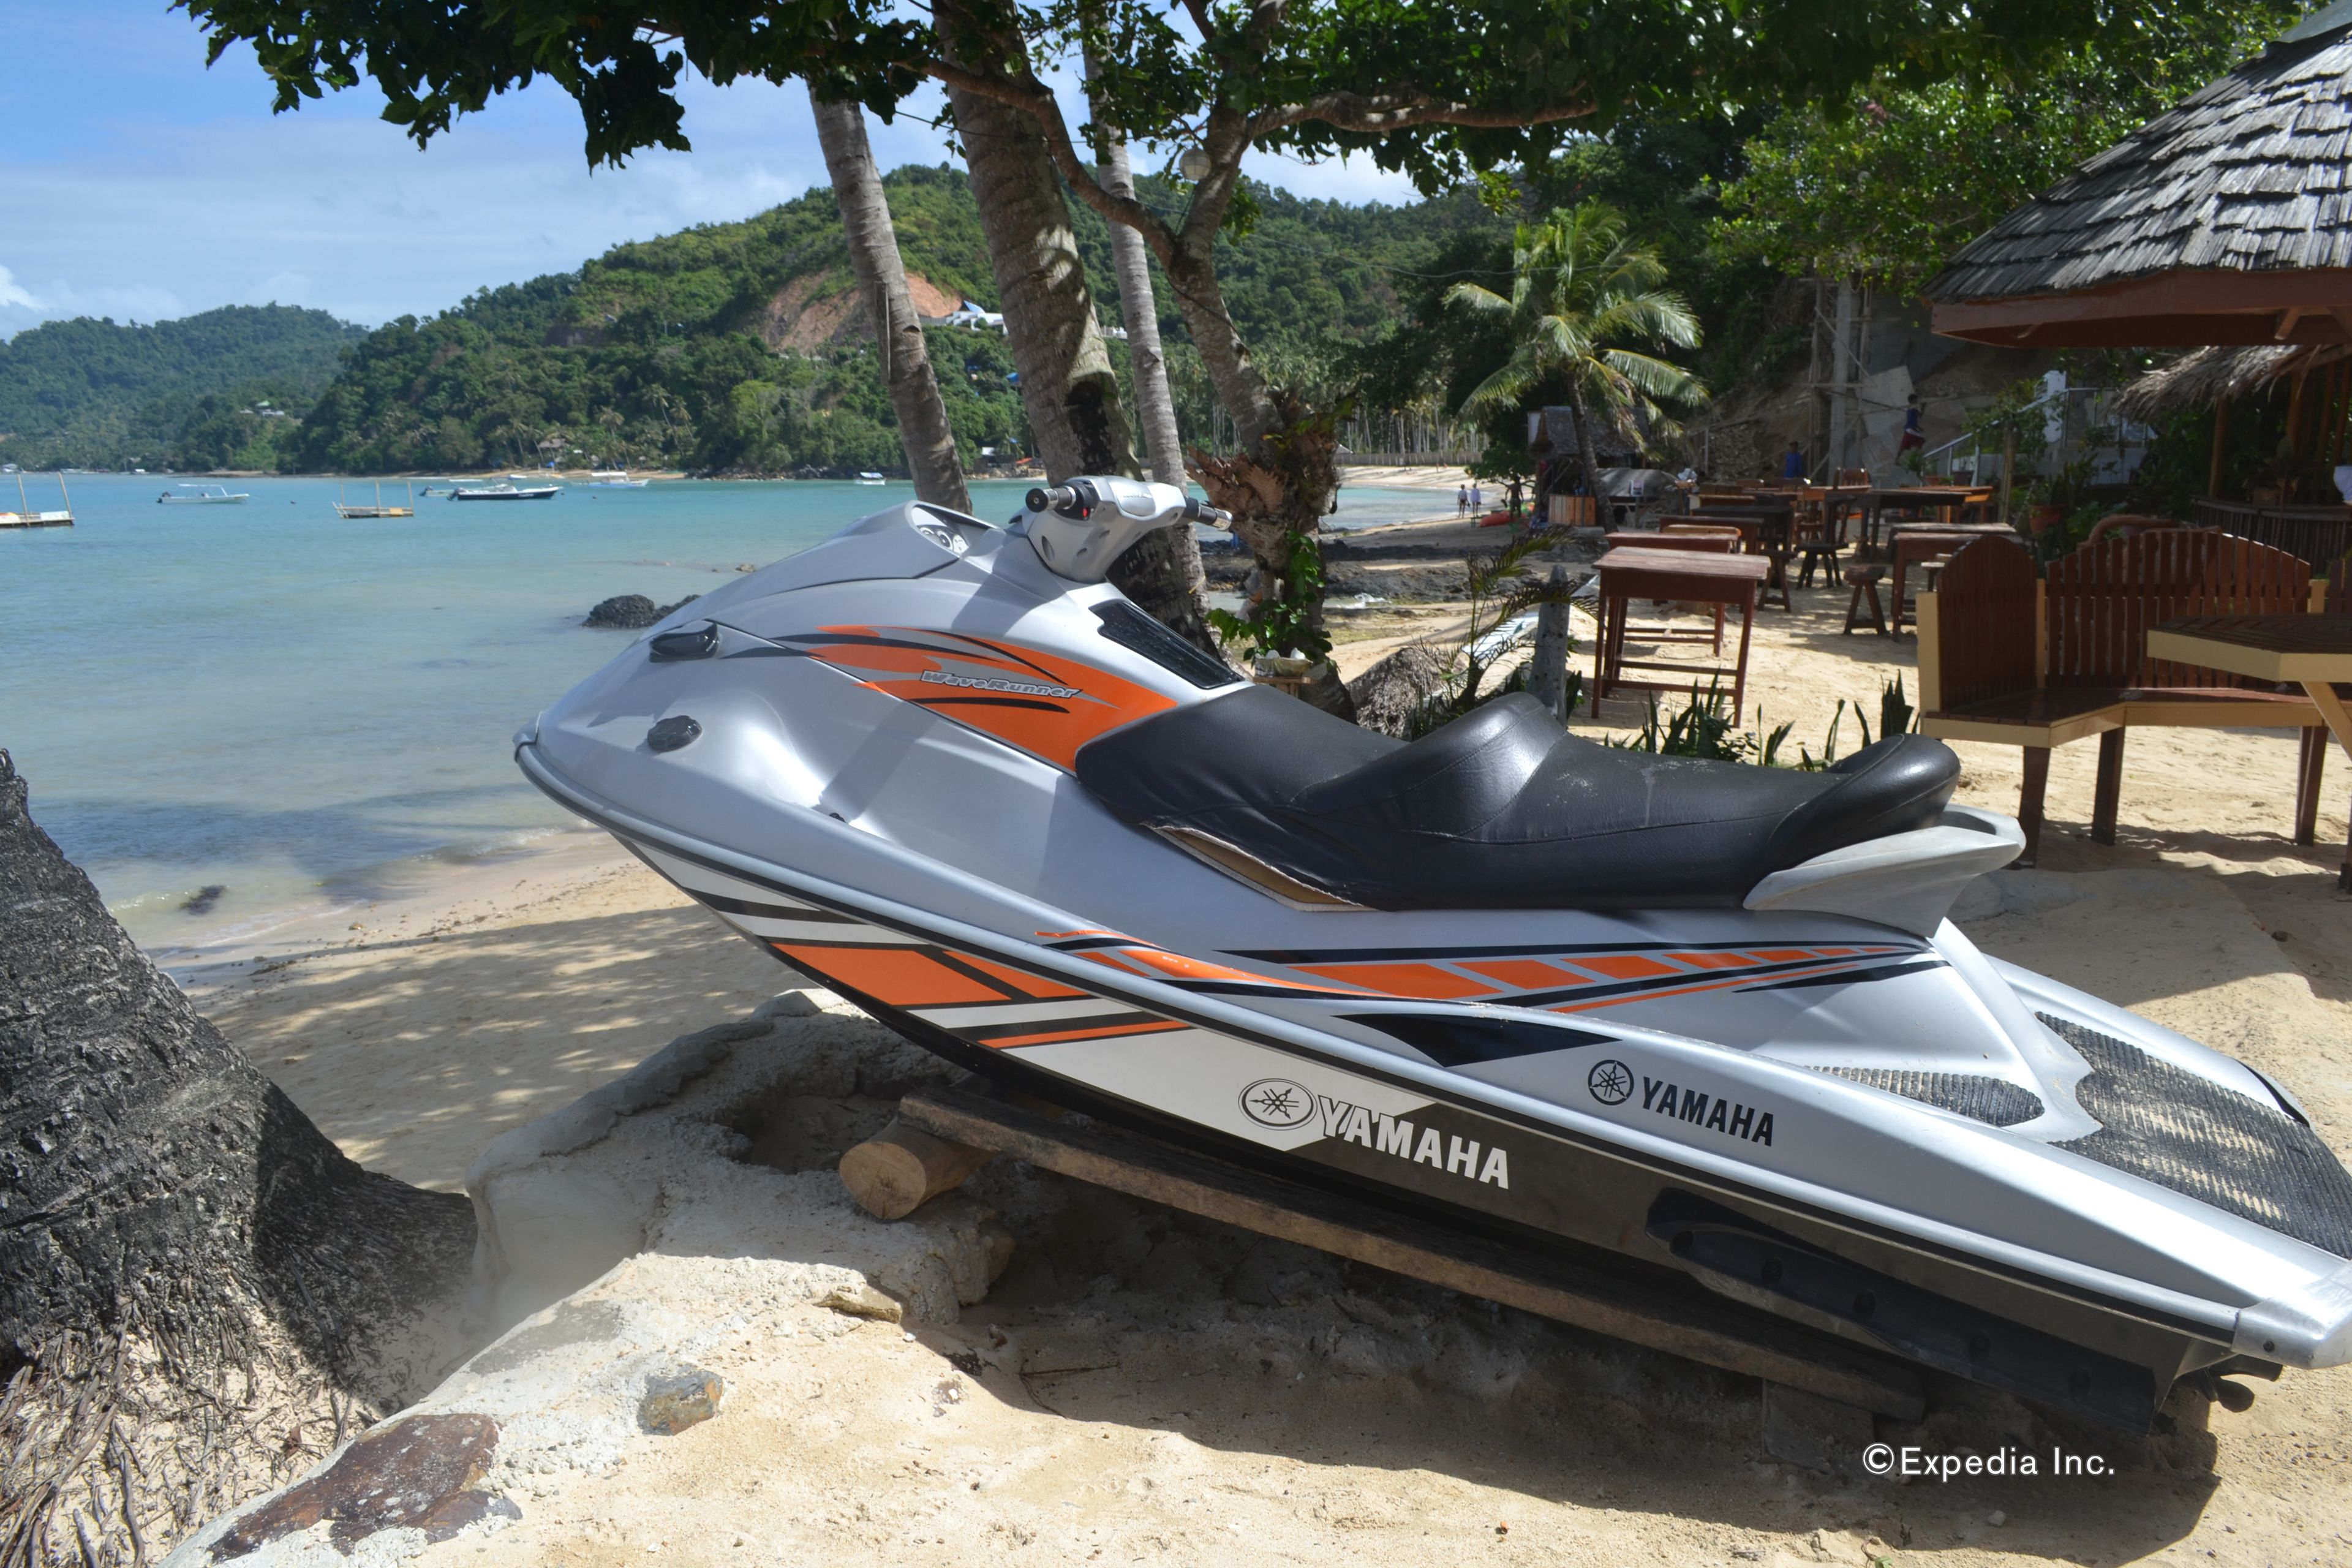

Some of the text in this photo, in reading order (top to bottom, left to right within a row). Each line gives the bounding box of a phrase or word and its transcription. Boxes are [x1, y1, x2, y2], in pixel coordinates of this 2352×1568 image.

[921, 670, 1082, 698] WaveRunner
[1317, 1095, 1509, 1189] YAMAHA
[1642, 1076, 1774, 1147] YAMAHA
